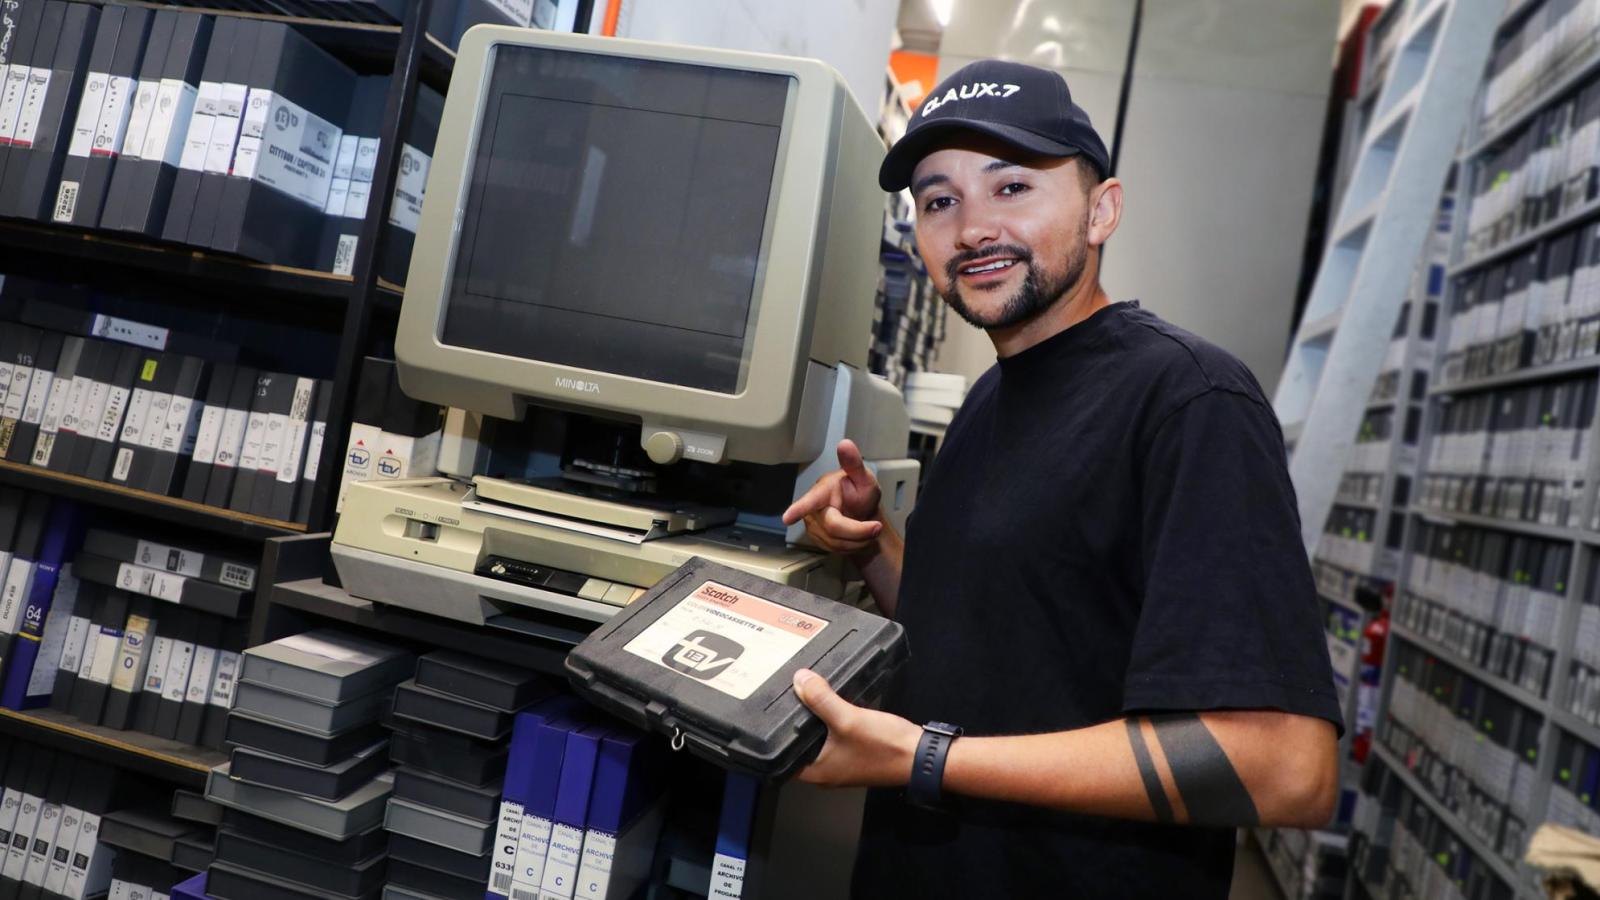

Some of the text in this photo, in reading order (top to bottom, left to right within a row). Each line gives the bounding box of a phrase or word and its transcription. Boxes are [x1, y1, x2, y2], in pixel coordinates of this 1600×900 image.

[555, 377, 600, 393] MINOLTA
[701, 586, 739, 605] Scotch
[26, 604, 42, 621] 64
[687, 650, 704, 662] 13
[504, 845, 514, 855] C
[526, 867, 534, 877] C
[555, 877, 563, 887] C
[590, 883, 598, 892] C
